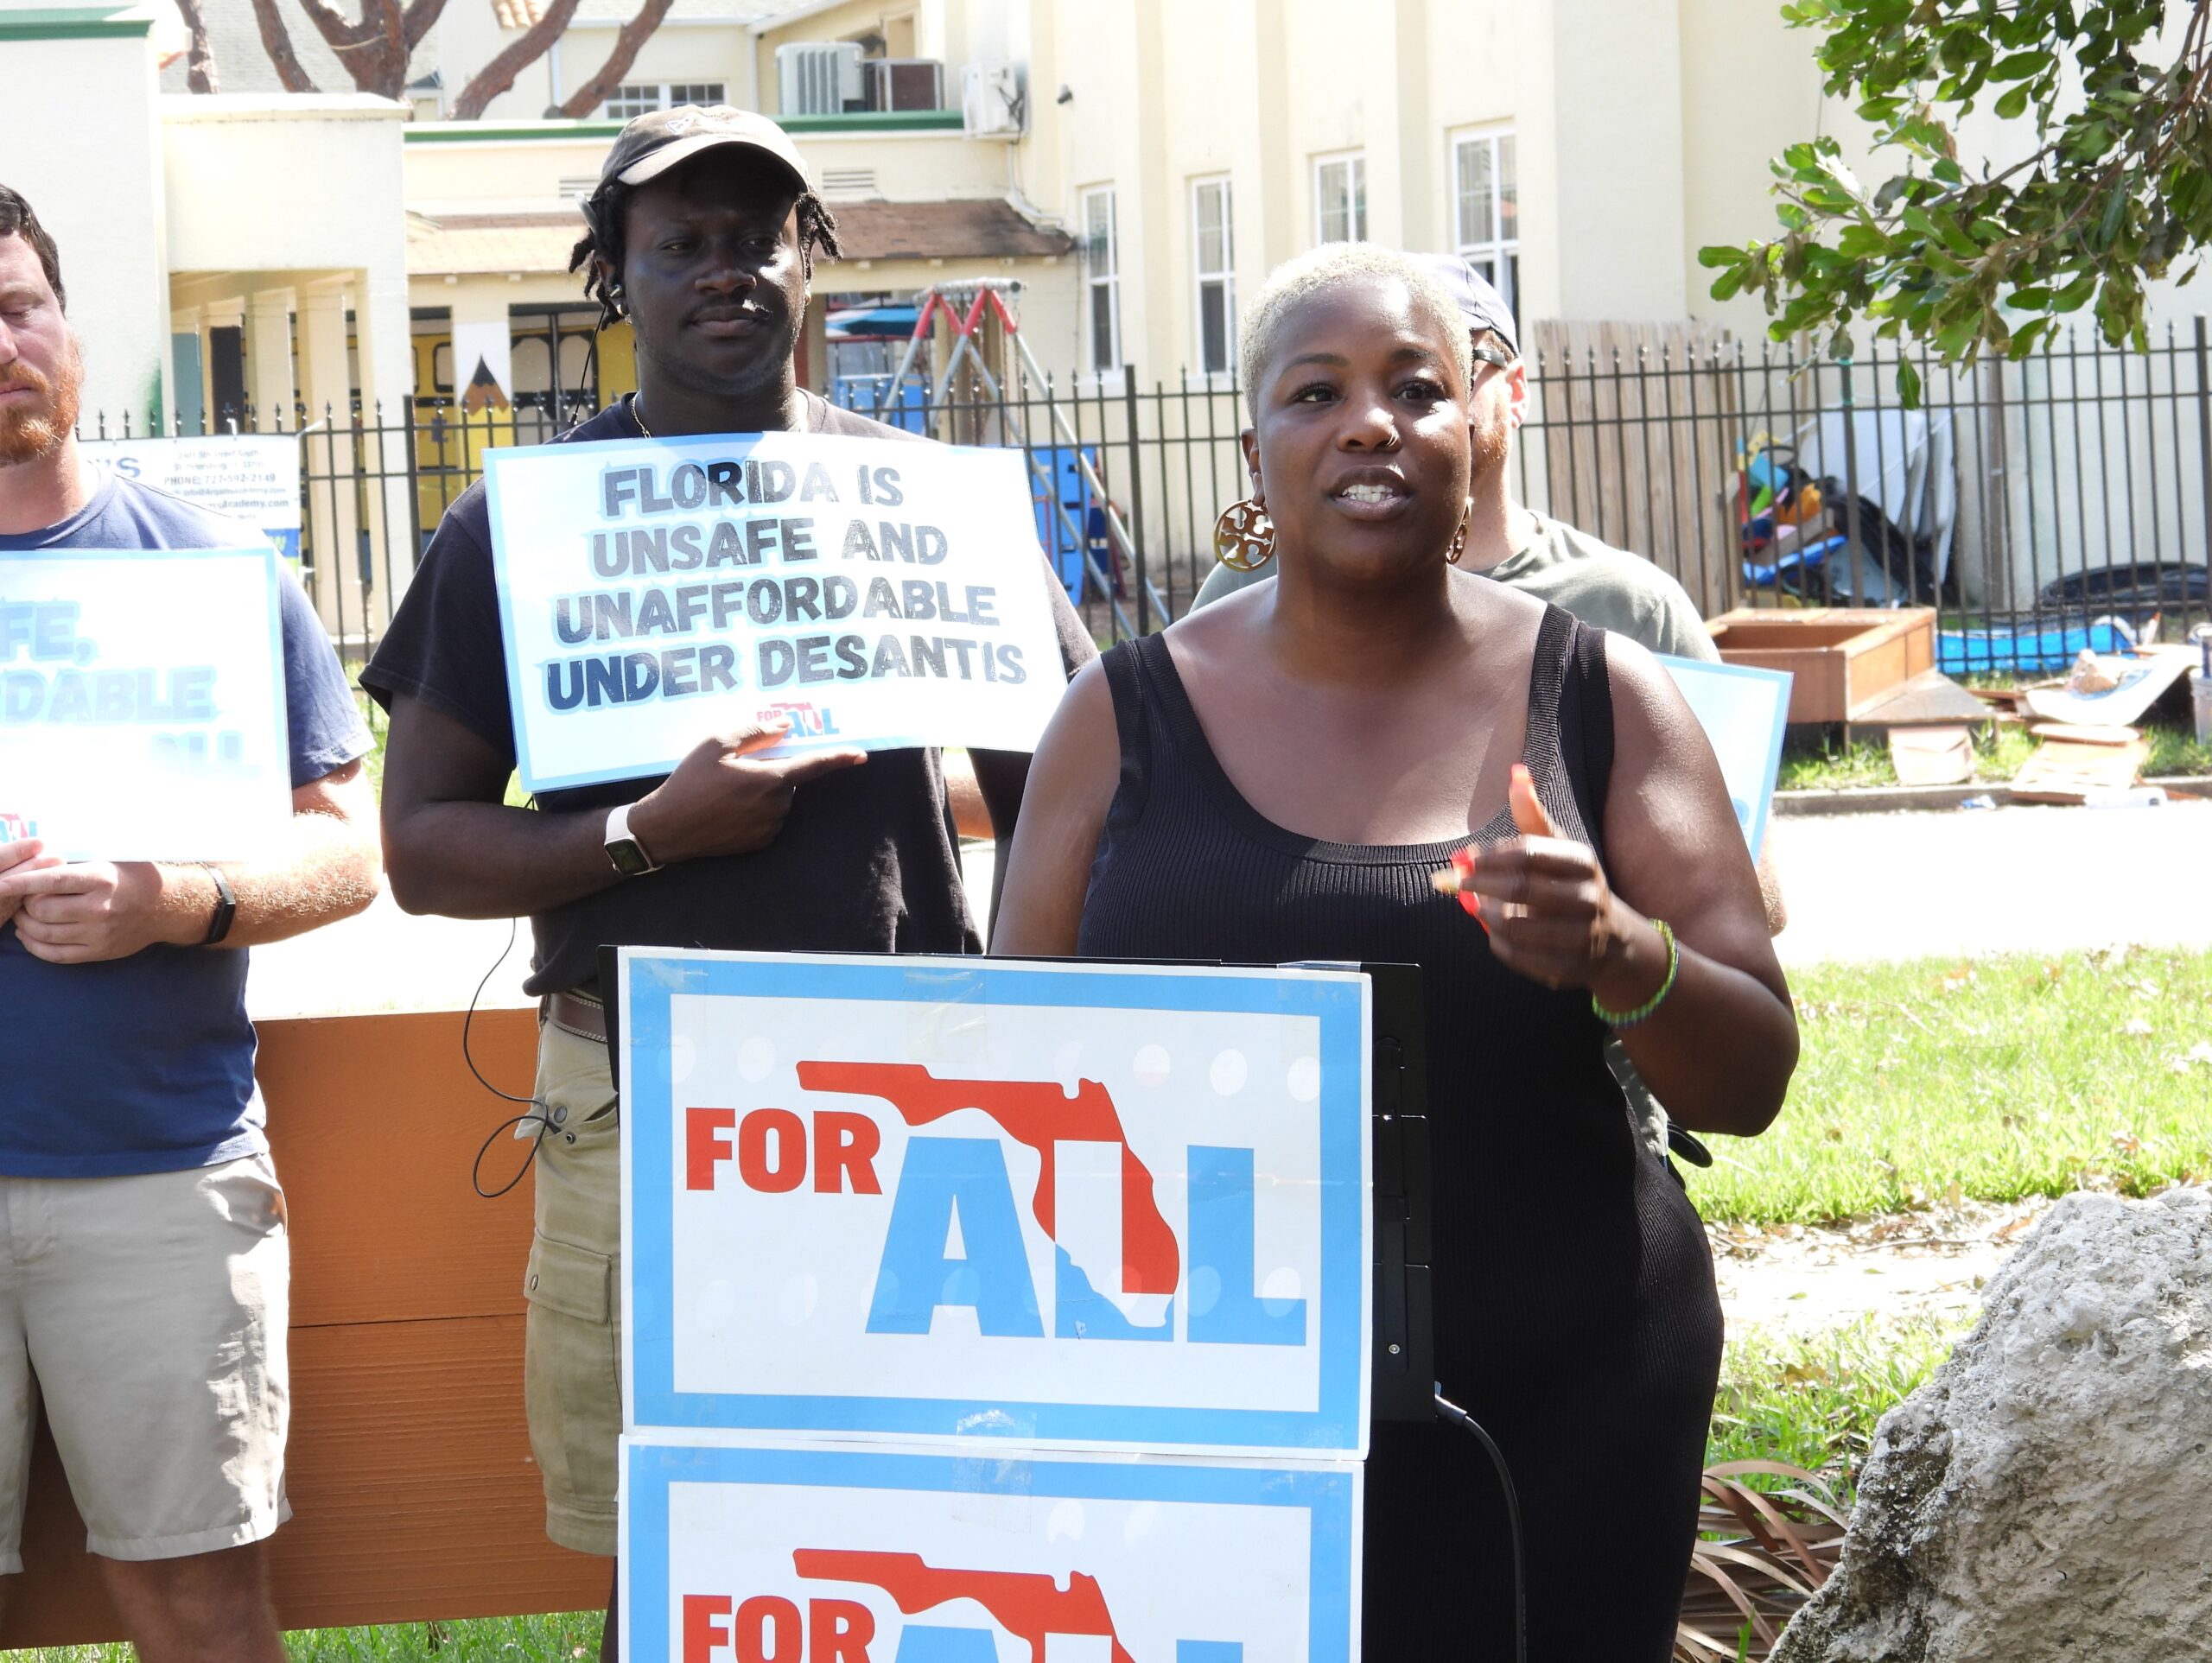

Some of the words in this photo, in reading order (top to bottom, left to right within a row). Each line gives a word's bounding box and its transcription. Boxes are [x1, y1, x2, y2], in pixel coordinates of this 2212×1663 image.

[164, 475, 201, 486] PHONE:
[206, 473, 276, 485] 727-592-2149
[605, 460, 839, 517] FLORIDA
[858, 464, 903, 506] IS
[593, 517, 817, 577] UNSAFE
[842, 519, 948, 565] AND
[556, 576, 1001, 644] UNAFFORDABLE
[547, 645, 737, 710] UNDER
[760, 635, 1027, 689] DESANTIS
[686, 1107, 882, 1195] FOR
[865, 1136, 1306, 1346] ALL
[683, 1594, 874, 1663] FOR
